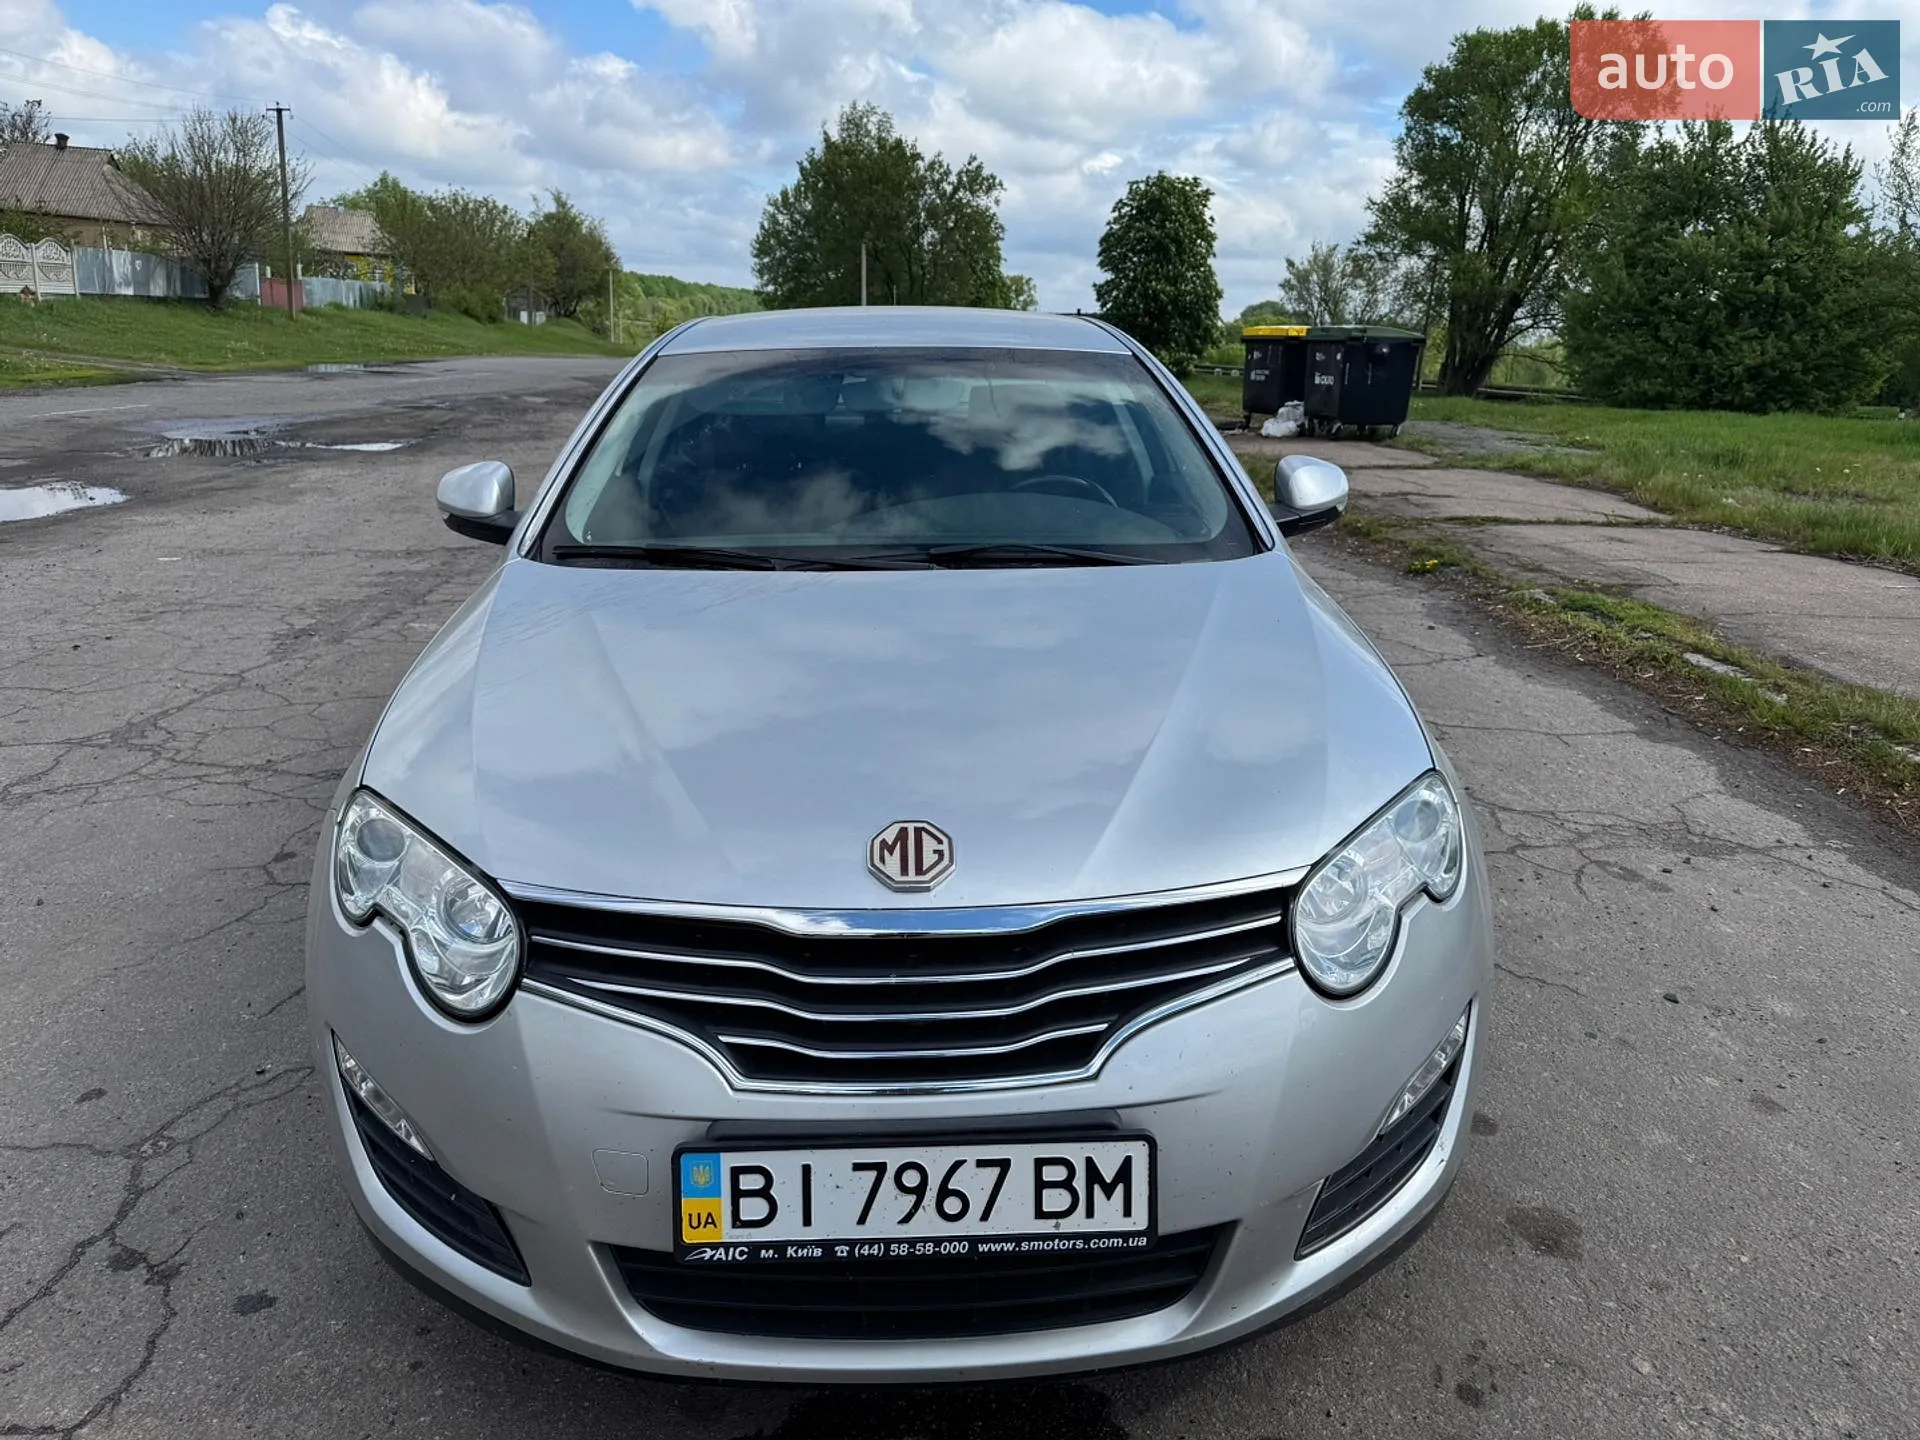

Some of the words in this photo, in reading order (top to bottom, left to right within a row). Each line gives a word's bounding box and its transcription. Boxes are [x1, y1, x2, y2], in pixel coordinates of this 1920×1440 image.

[879, 826, 945, 877] MG
[851, 1157, 1012, 1226] 7967
[1033, 1154, 1134, 1221] BM
[688, 1212, 718, 1230] UA
[786, 1246, 823, 1258] Київ
[854, 1243, 884, 1257] (44)
[889, 1241, 969, 1256] 58-58-000
[978, 1236, 1147, 1252] www.smotors.com.ua
